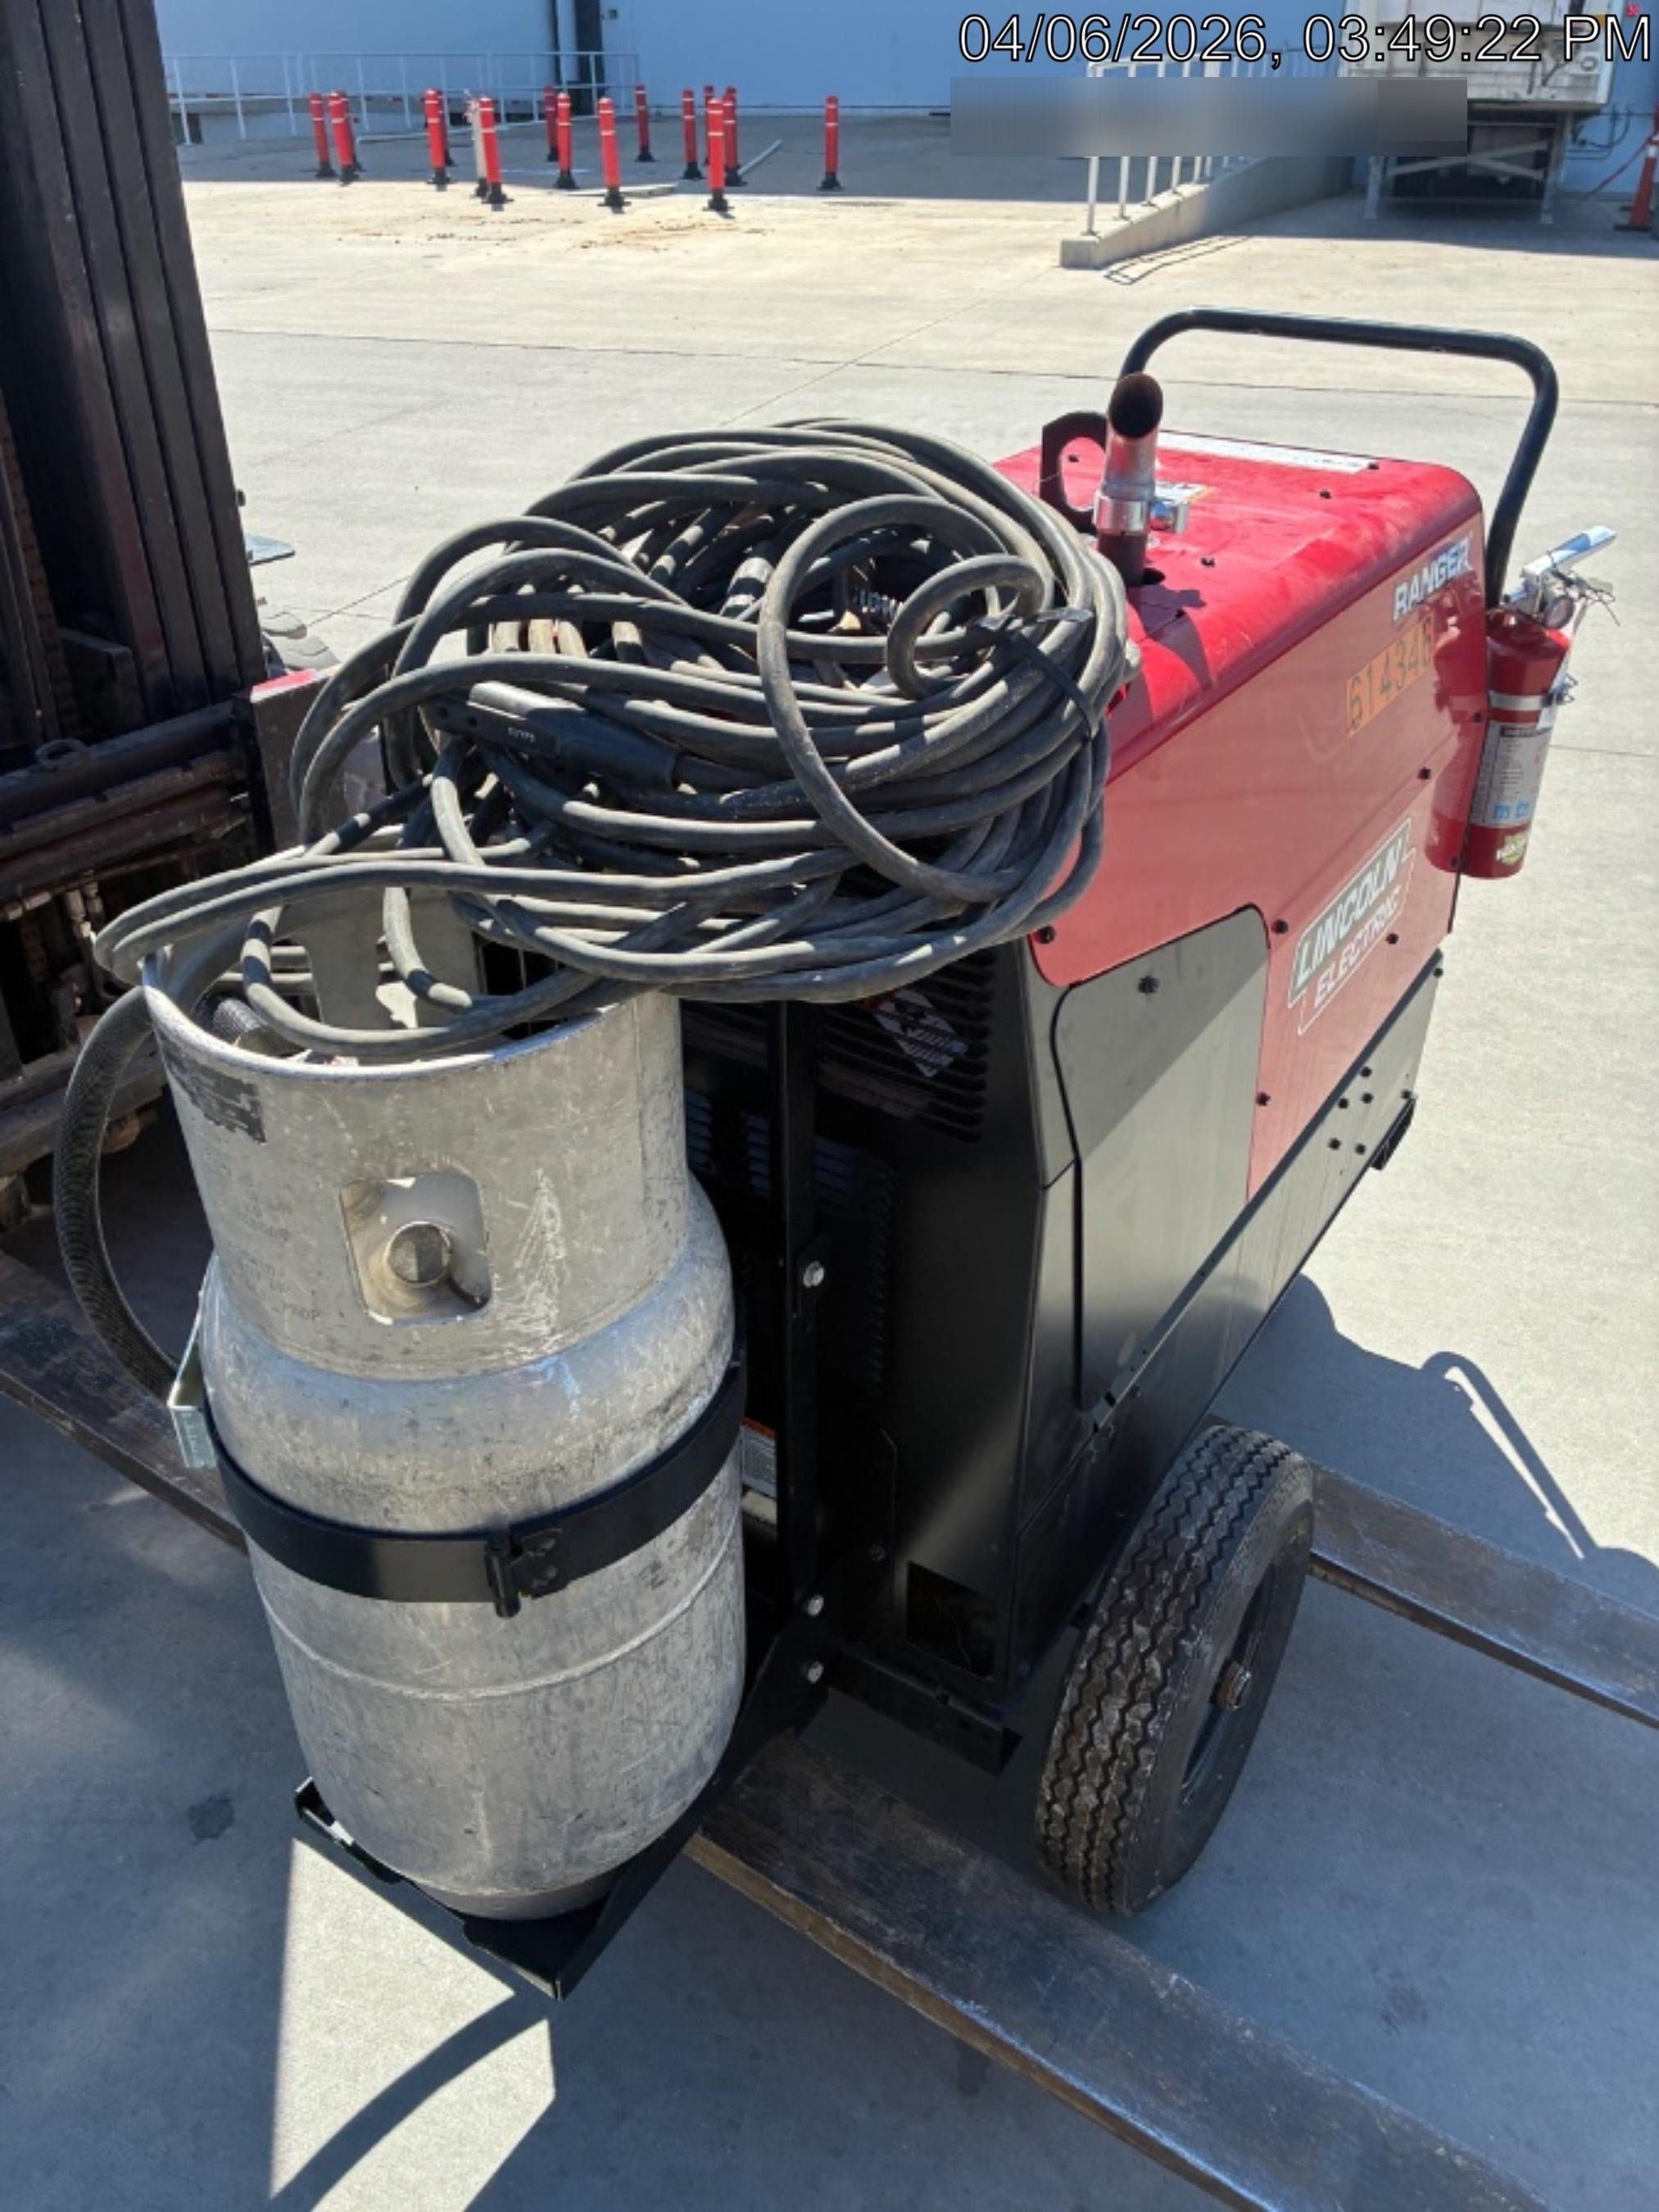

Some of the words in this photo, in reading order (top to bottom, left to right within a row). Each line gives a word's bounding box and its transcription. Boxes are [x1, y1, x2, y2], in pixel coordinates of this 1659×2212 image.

[1393, 536, 1473, 622] RANGER
[1296, 837, 1403, 989] LINCOLN
[1314, 884, 1402, 1009] ELECTRIC
